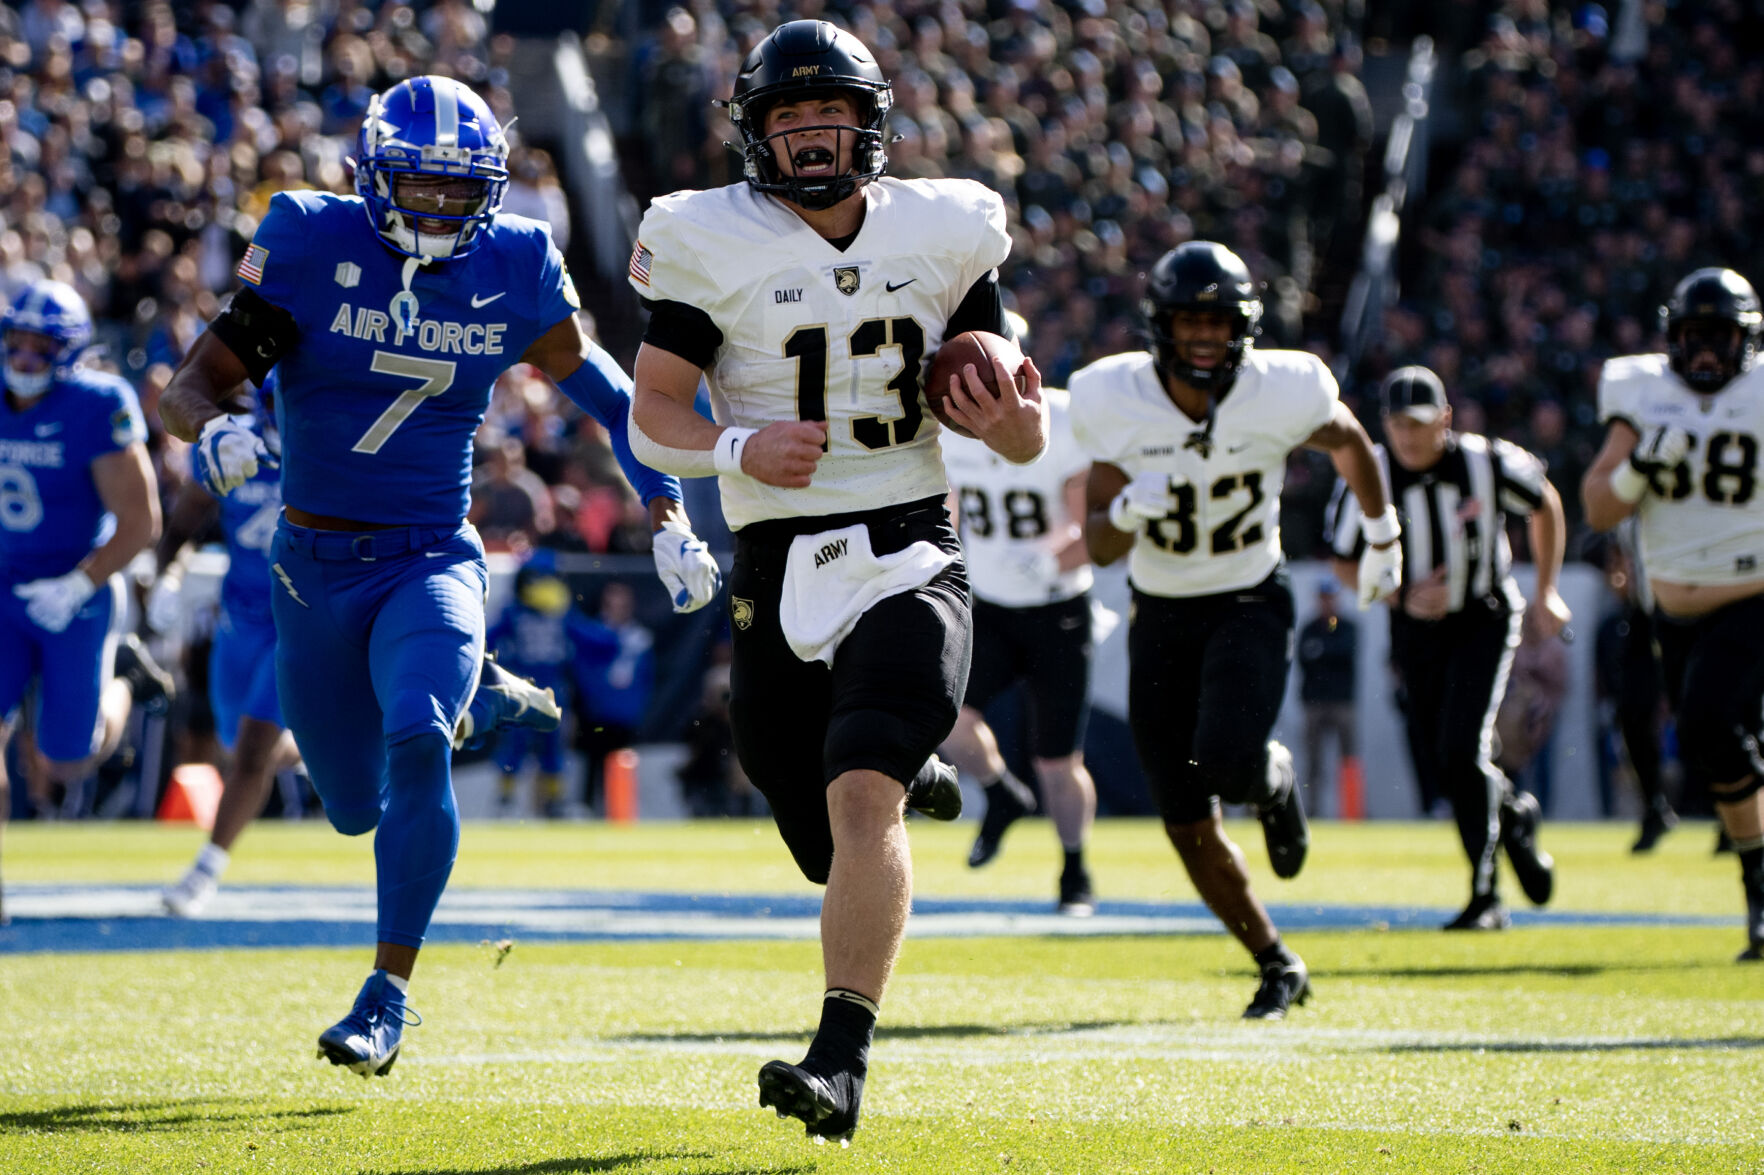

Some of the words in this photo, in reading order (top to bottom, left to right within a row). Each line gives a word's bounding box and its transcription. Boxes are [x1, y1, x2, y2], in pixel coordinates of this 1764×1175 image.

[791, 65, 820, 78] ARMY
[774, 288, 804, 304] DAILY
[329, 303, 389, 343] AIR
[351, 350, 457, 455] 7
[781, 314, 926, 456] 13
[1145, 469, 1265, 558] 82
[814, 537, 848, 570] ARMY
